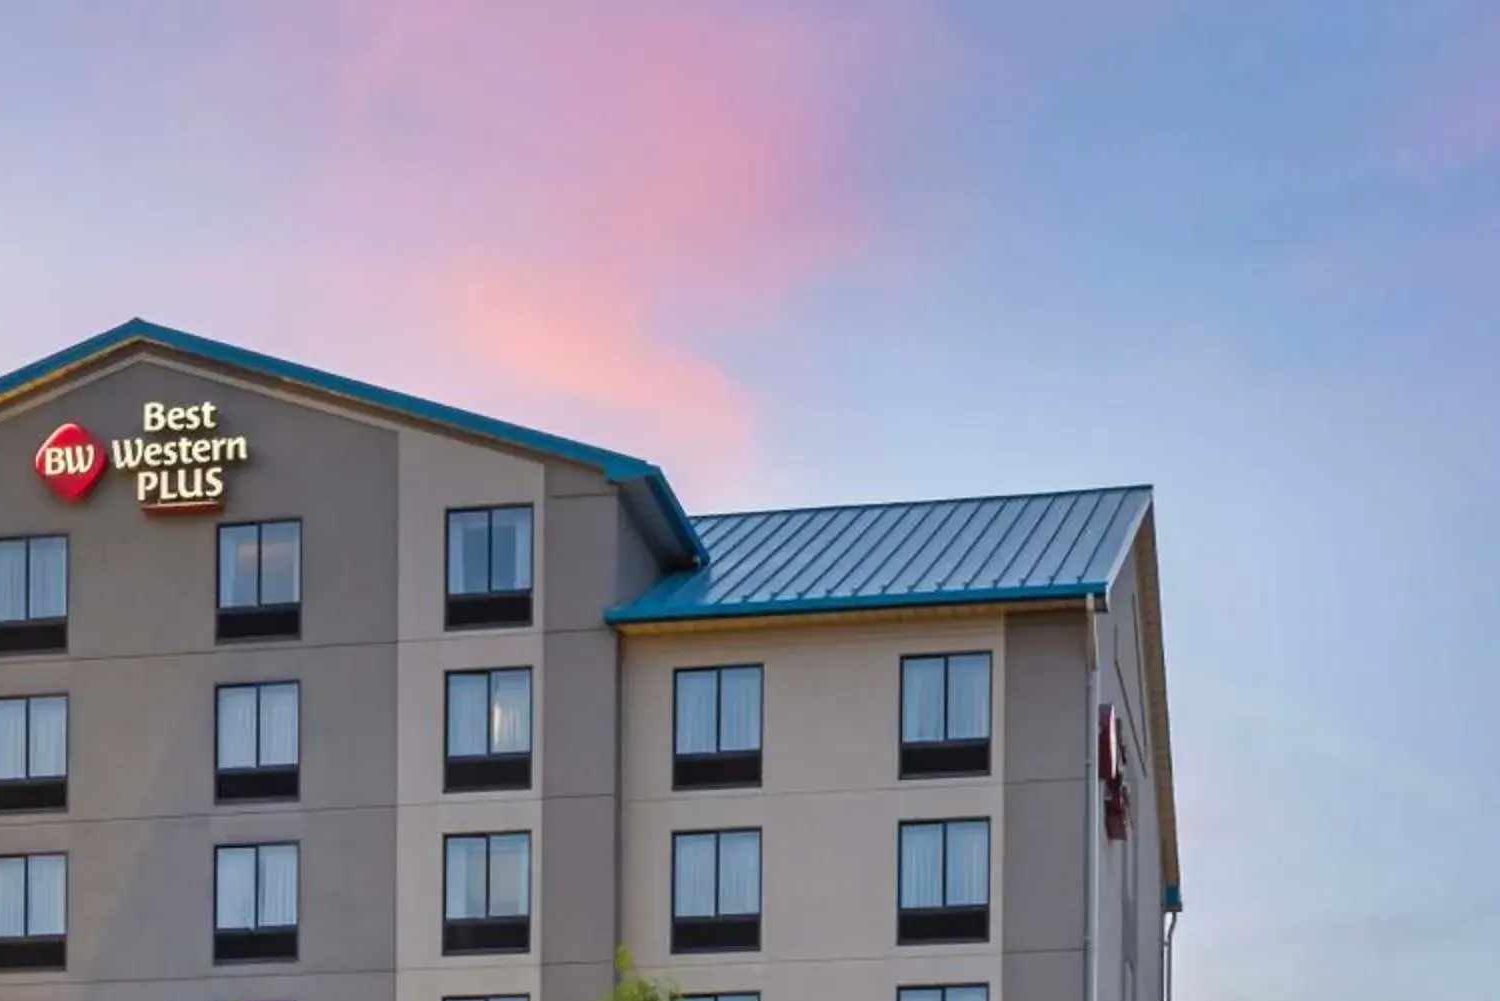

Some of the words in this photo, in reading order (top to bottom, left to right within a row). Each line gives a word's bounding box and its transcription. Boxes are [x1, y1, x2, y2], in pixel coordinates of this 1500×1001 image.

[143, 401, 216, 432] Best
[44, 446, 95, 475] BW
[112, 436, 248, 469] Western
[137, 467, 223, 500] PLUS
